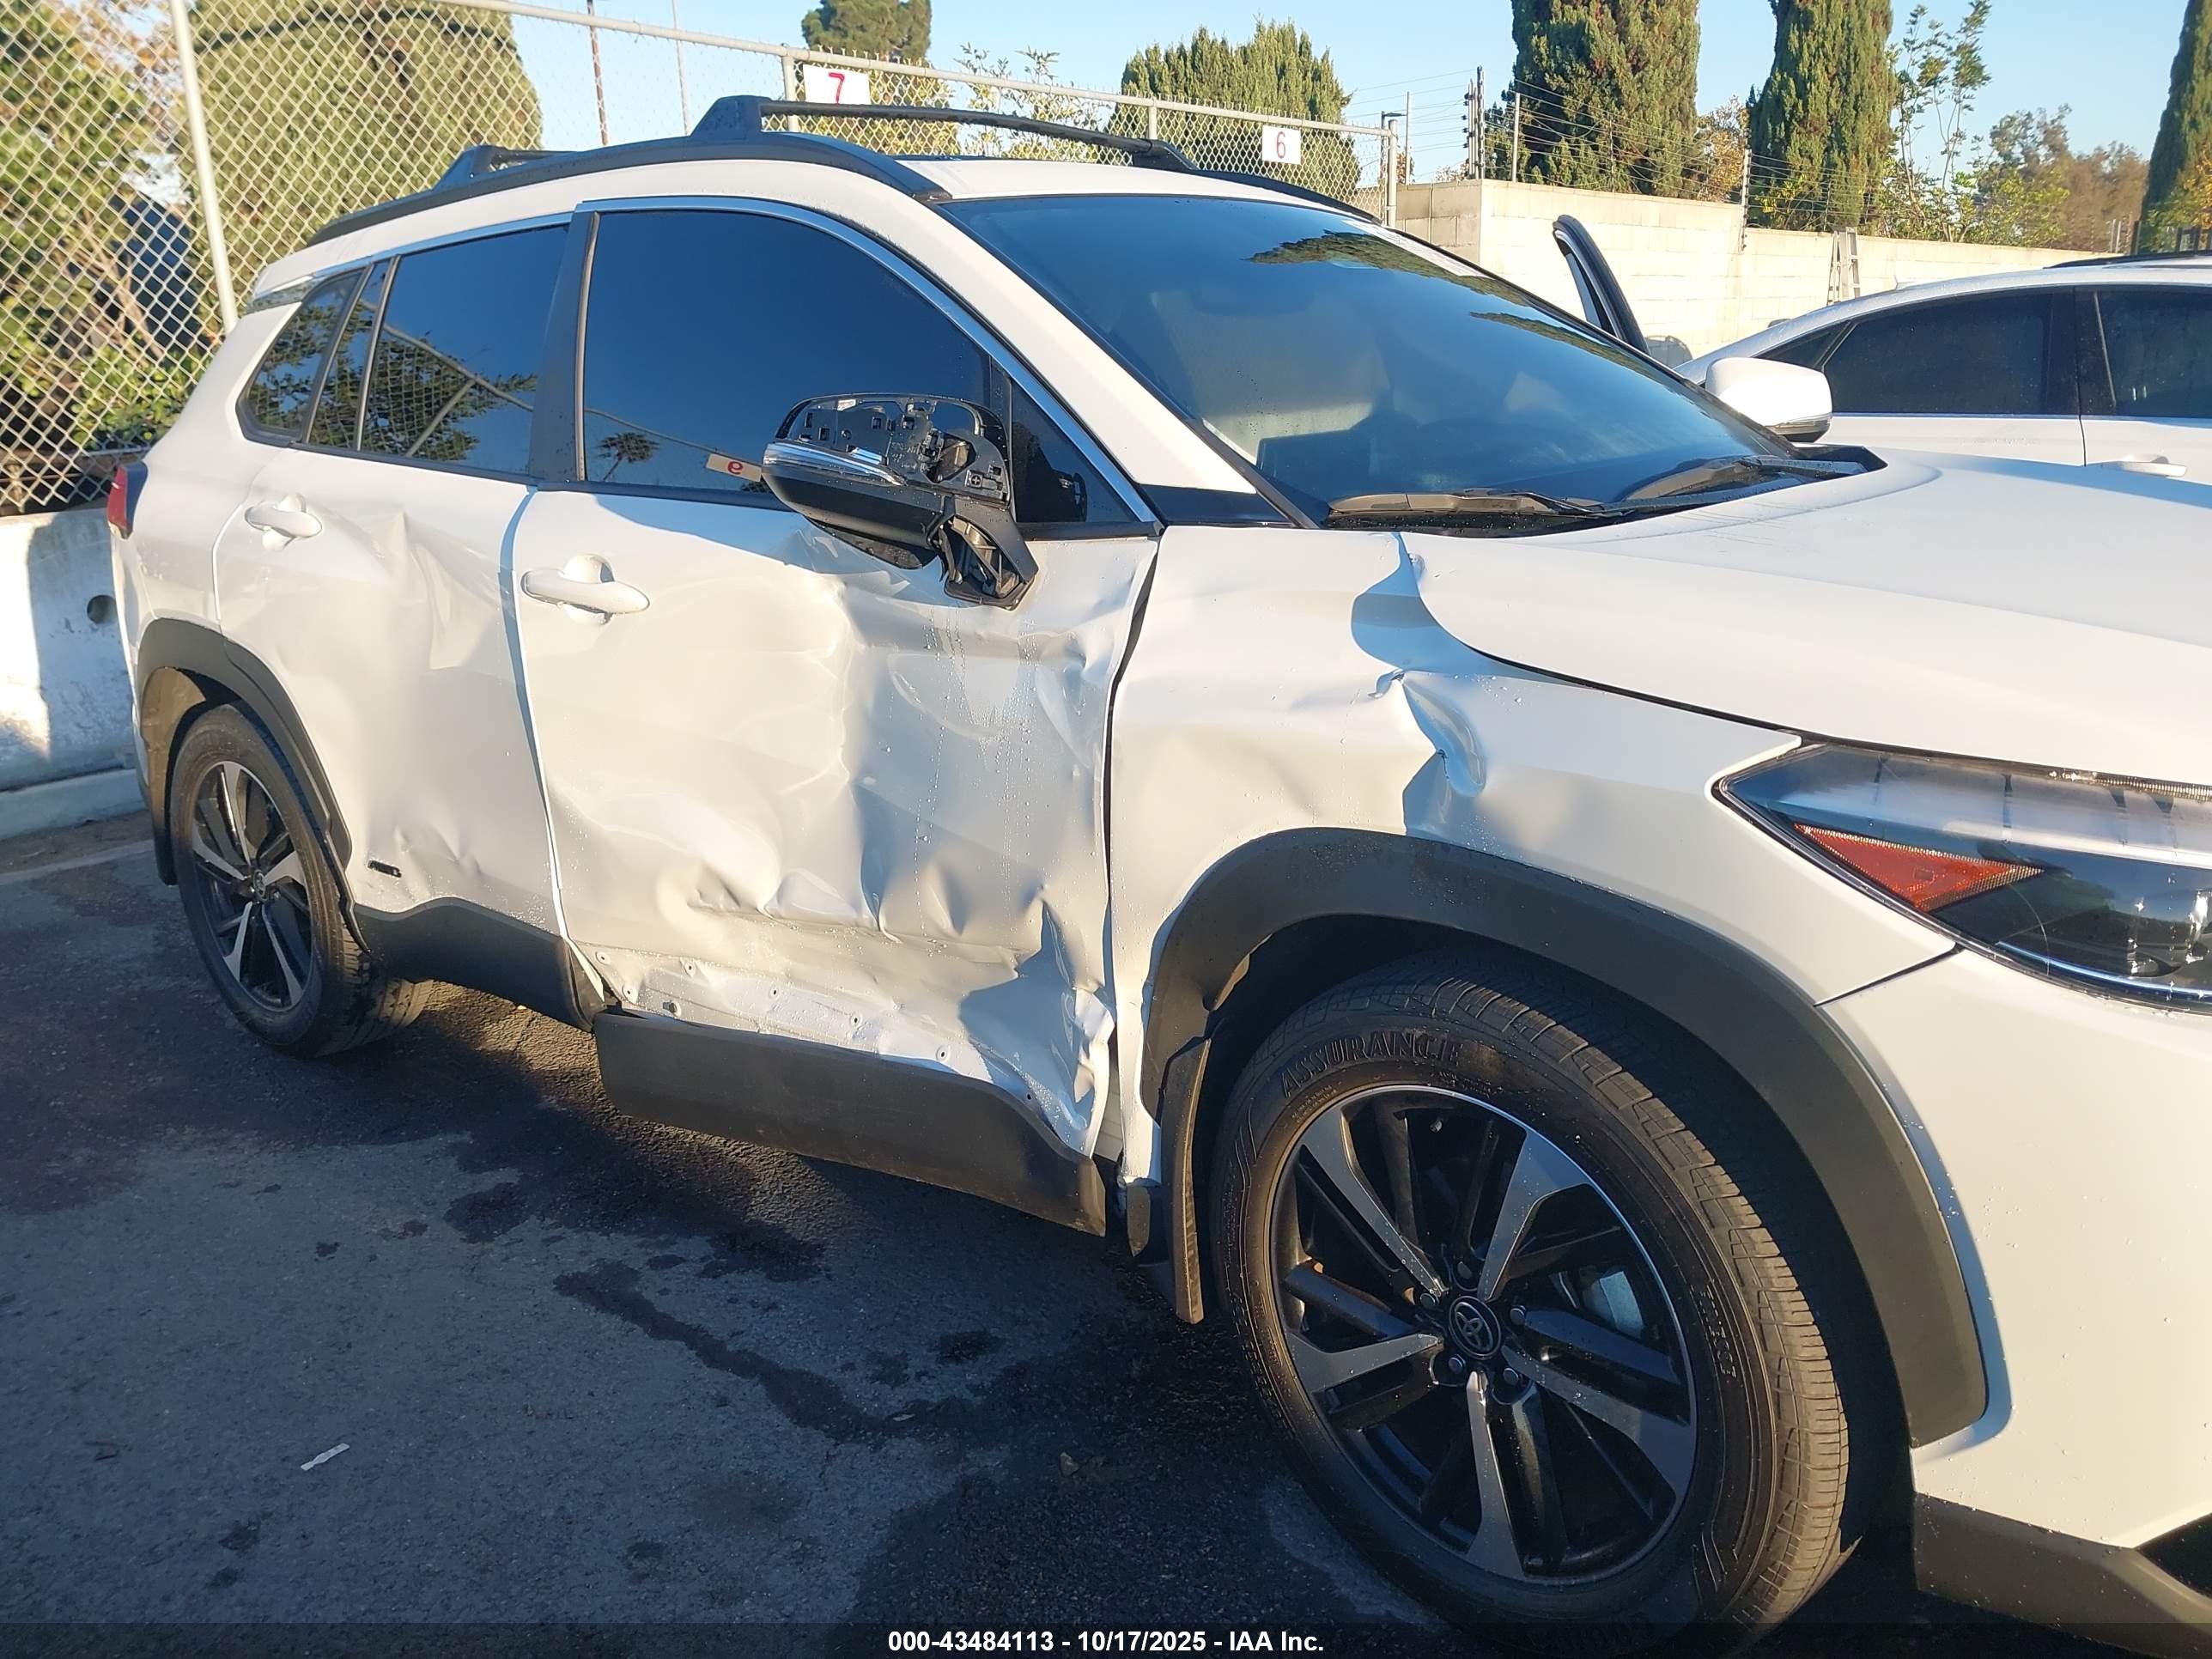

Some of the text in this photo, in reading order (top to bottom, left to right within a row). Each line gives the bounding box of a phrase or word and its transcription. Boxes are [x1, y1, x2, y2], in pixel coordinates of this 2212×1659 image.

[828, 71, 845, 104] 7
[1276, 131, 1286, 159] 6
[1280, 1030, 1463, 1098] ASSURANCE
